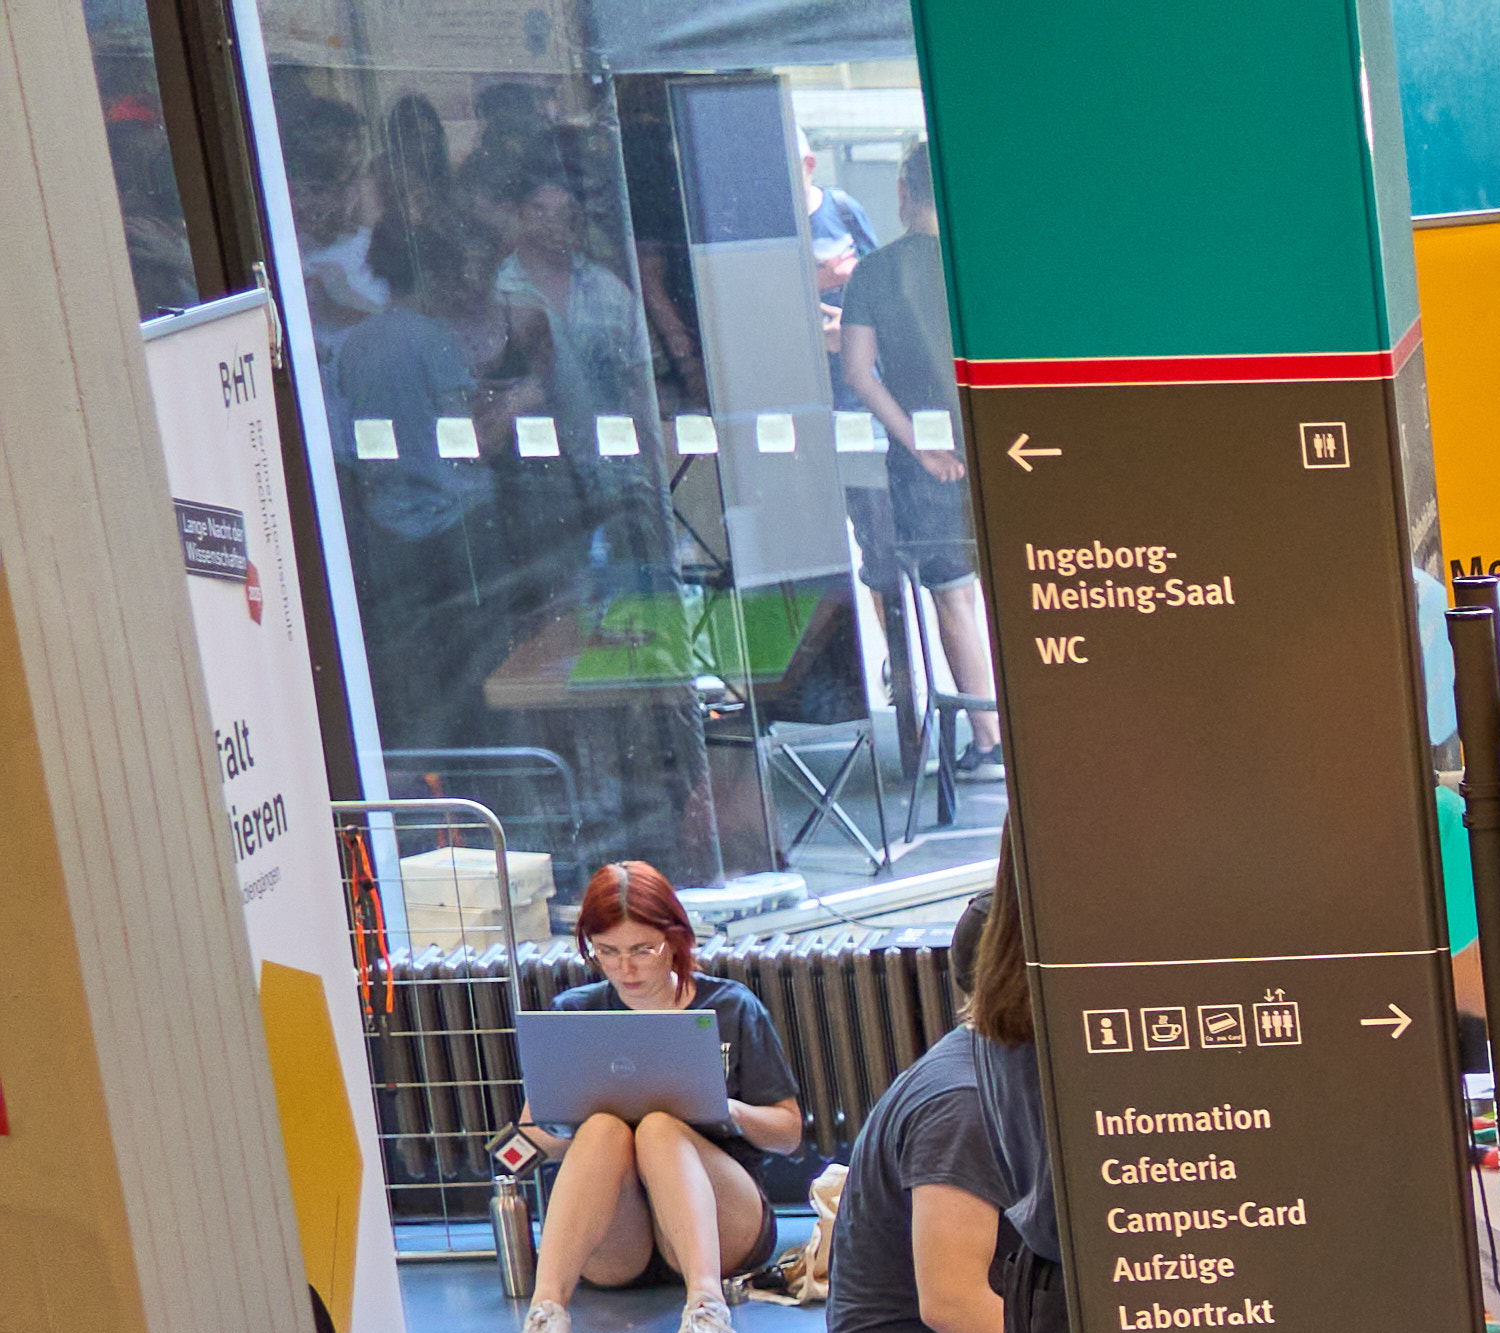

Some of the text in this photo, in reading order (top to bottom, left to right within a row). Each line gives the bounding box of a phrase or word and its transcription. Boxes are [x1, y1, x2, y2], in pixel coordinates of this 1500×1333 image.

[219, 352, 257, 409] BHT
[207, 517, 229, 537] Nacht
[1026, 540, 1178, 577] Ingeborg-
[1031, 575, 1236, 613] Meising-Saal
[1035, 636, 1089, 665] WC
[229, 792, 288, 865] ieren
[1095, 1102, 1272, 1137] Information
[1101, 1153, 1238, 1187] Cafeteria
[1107, 1198, 1307, 1239] Campus-Card
[1113, 1250, 1236, 1287] Aufzüge
[1119, 1296, 1276, 1332] Labortrakt
